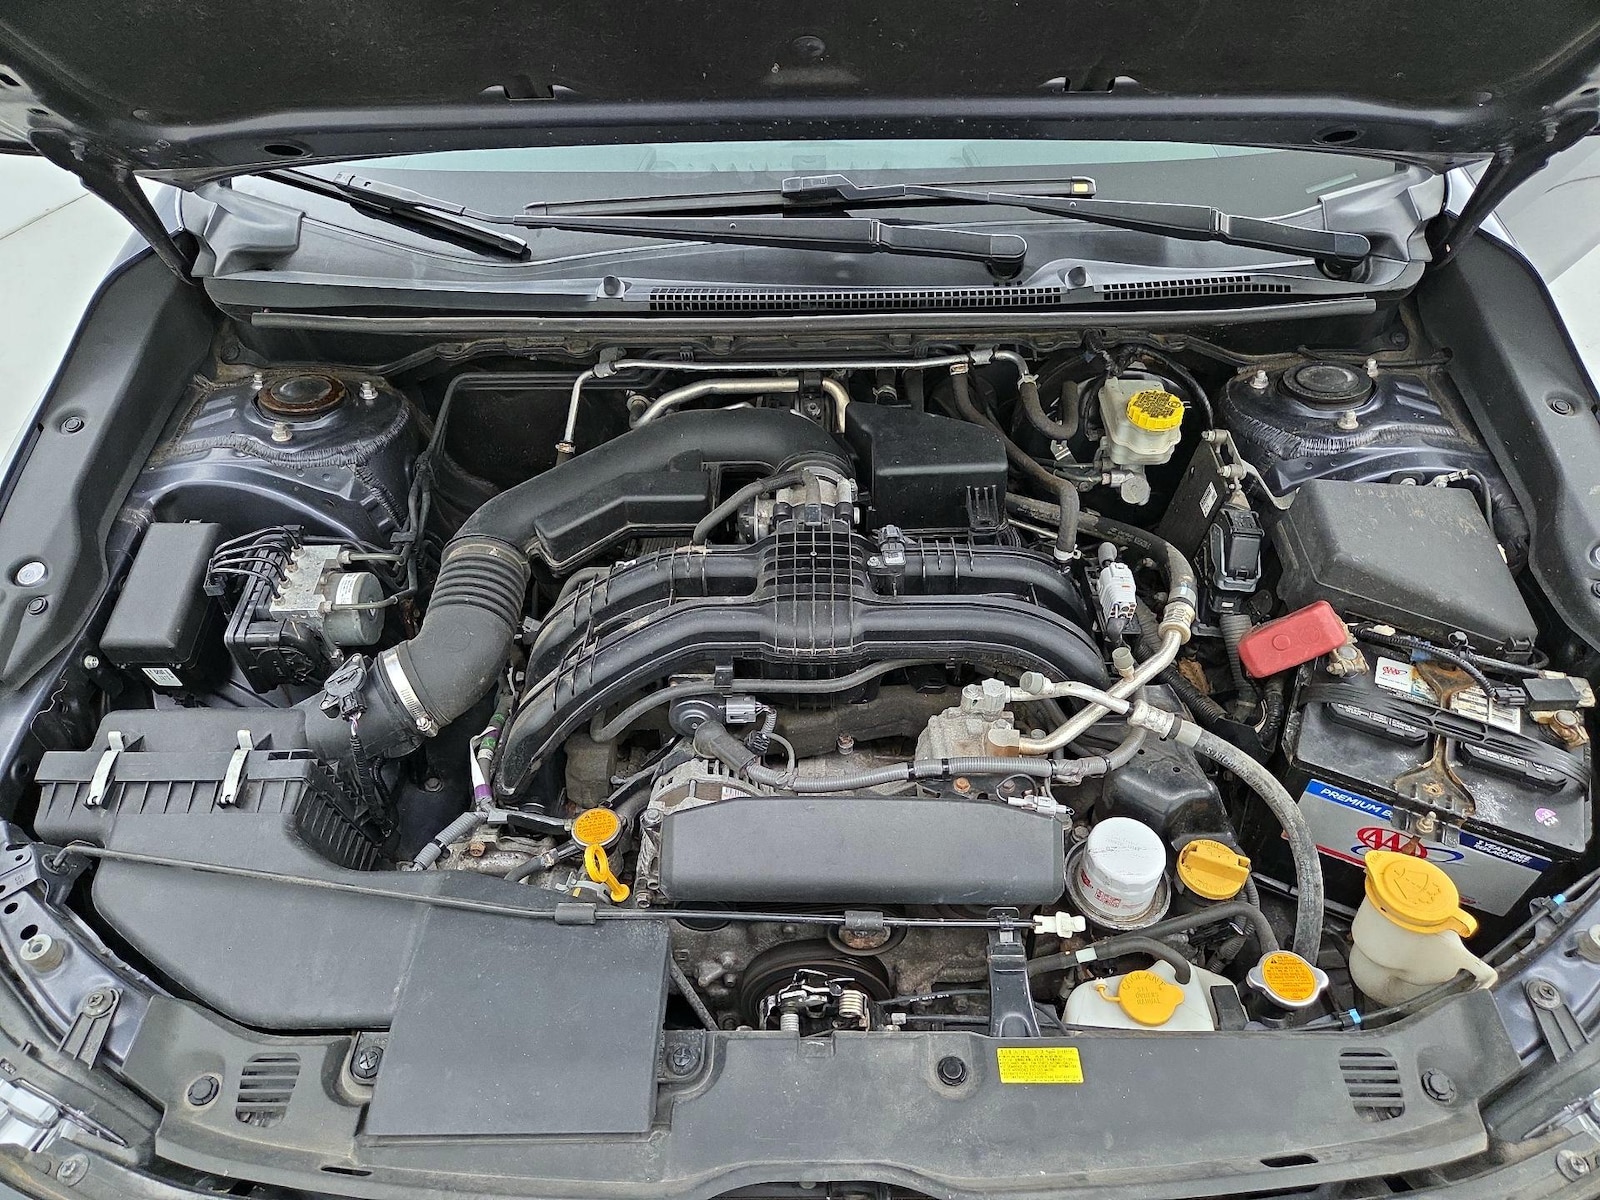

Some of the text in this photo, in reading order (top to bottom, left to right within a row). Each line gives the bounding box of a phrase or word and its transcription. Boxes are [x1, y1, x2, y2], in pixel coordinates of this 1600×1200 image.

[1320, 788, 1382, 813] PREMIUM
[1357, 827, 1428, 858] AA
[1483, 841, 1508, 854] YEAR
[1507, 849, 1532, 862] FREE
